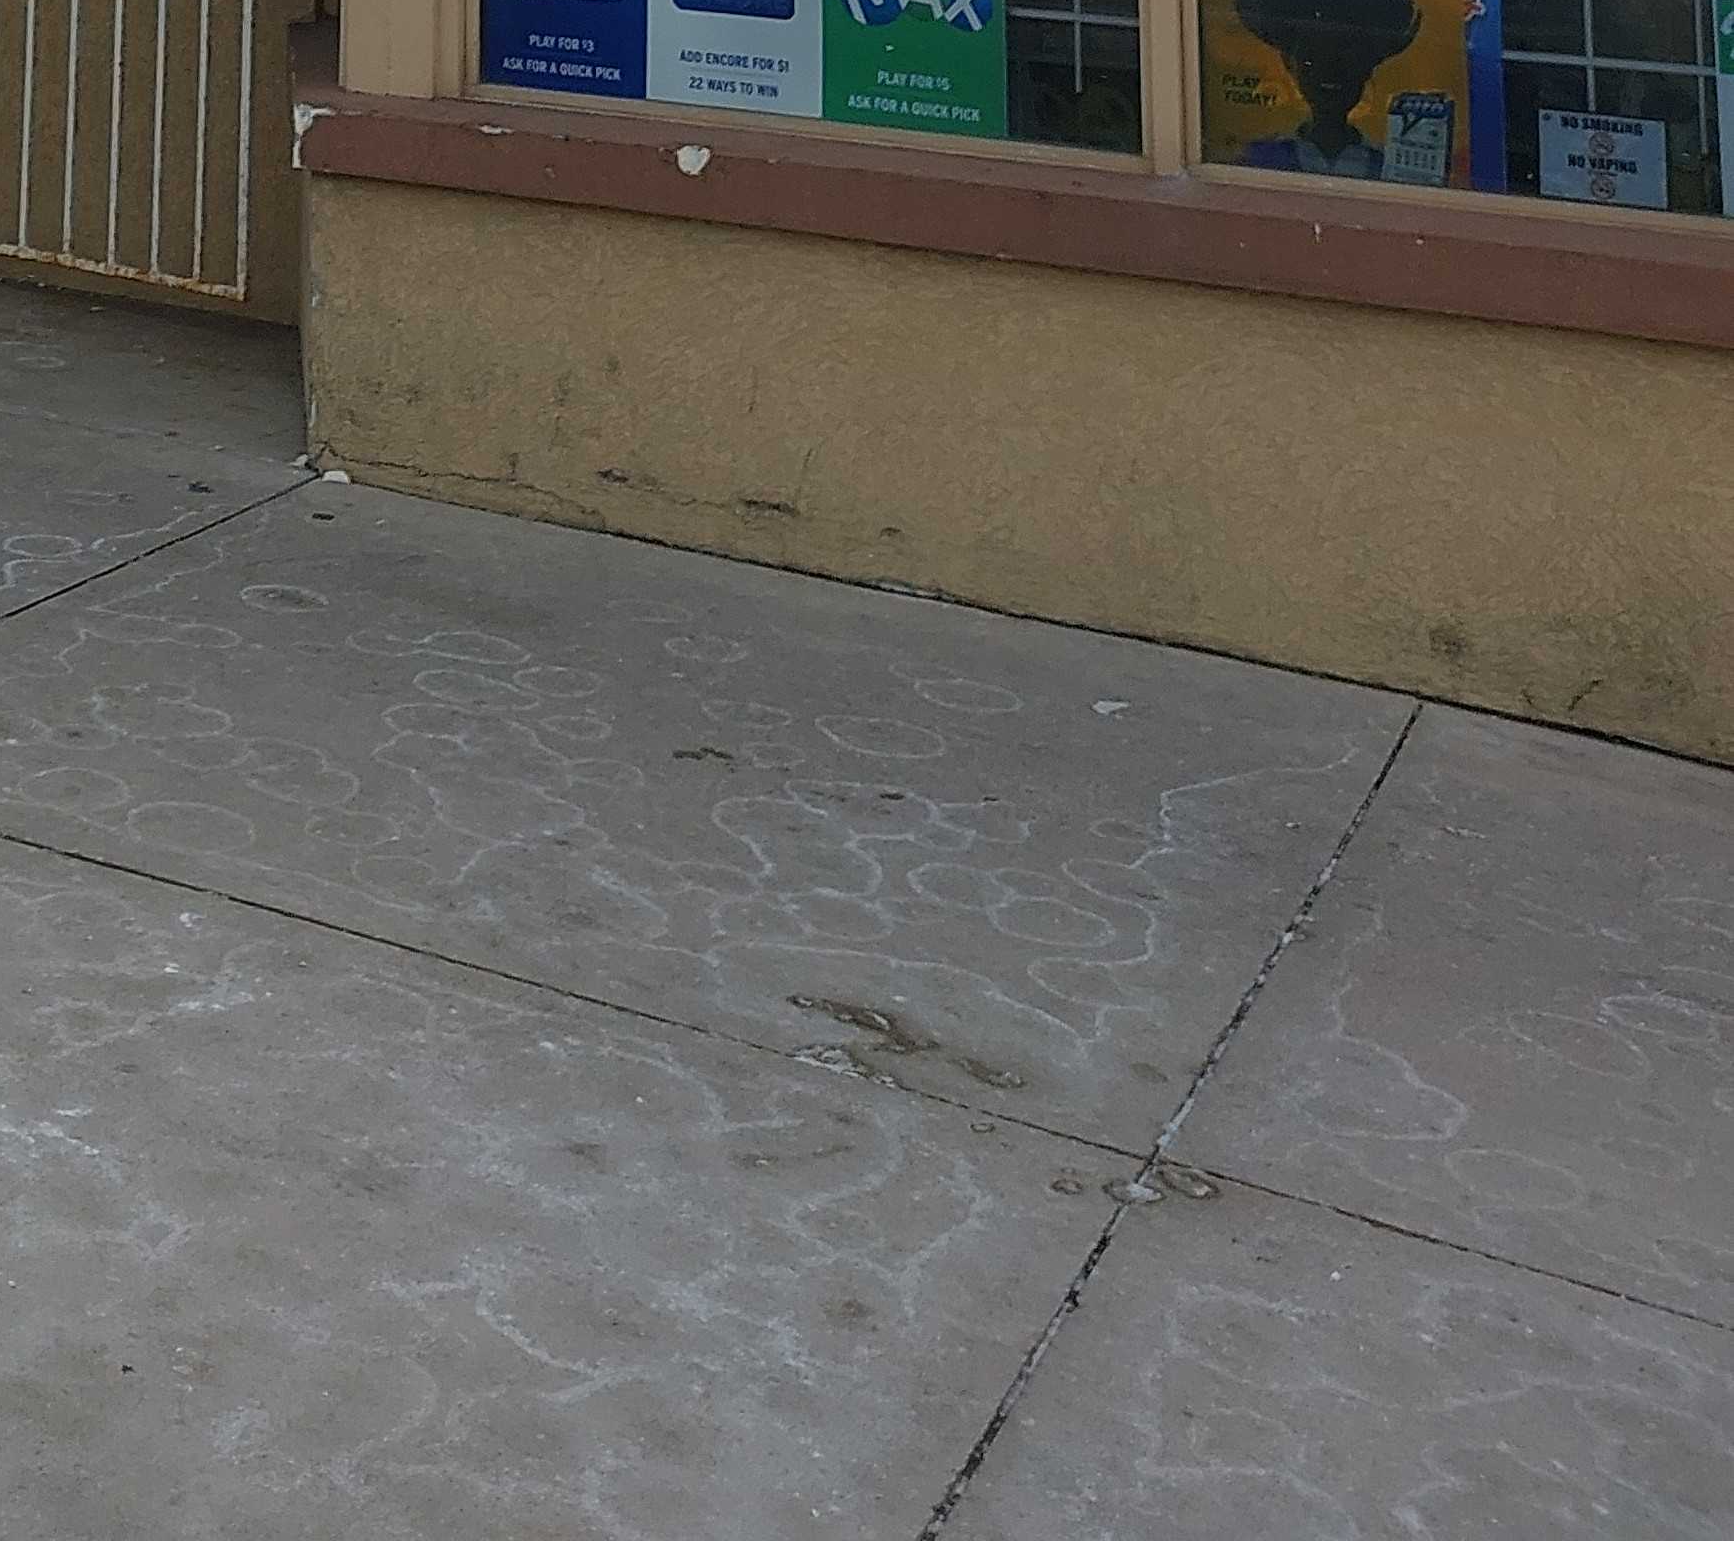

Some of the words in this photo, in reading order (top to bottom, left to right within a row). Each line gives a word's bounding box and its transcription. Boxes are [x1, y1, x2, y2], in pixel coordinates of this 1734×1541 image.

[529, 34, 555, 48] PLAY
[558, 36, 579, 51] FOR
[503, 57, 523, 71] ASK
[526, 59, 548, 73] FOR
[550, 62, 558, 75] A
[559, 64, 592, 78] QUICK
[596, 66, 621, 81] PICK
[679, 49, 703, 63] ADD
[706, 52, 749, 69] ENCORE
[753, 56, 775, 70] FOR
[778, 59, 790, 73] $1
[689, 76, 703, 90] 22
[707, 78, 736, 93] WAYS
[740, 82, 753, 95] TO
[756, 84, 779, 98] WIN
[877, 70, 907, 86] PLAY
[910, 73, 933, 88] FOR
[848, 94, 871, 109] ASK
[873, 97, 898, 112] FOR
[900, 99, 909, 114] A
[912, 101, 949, 118] QUICK
[952, 106, 981, 122] PICK
